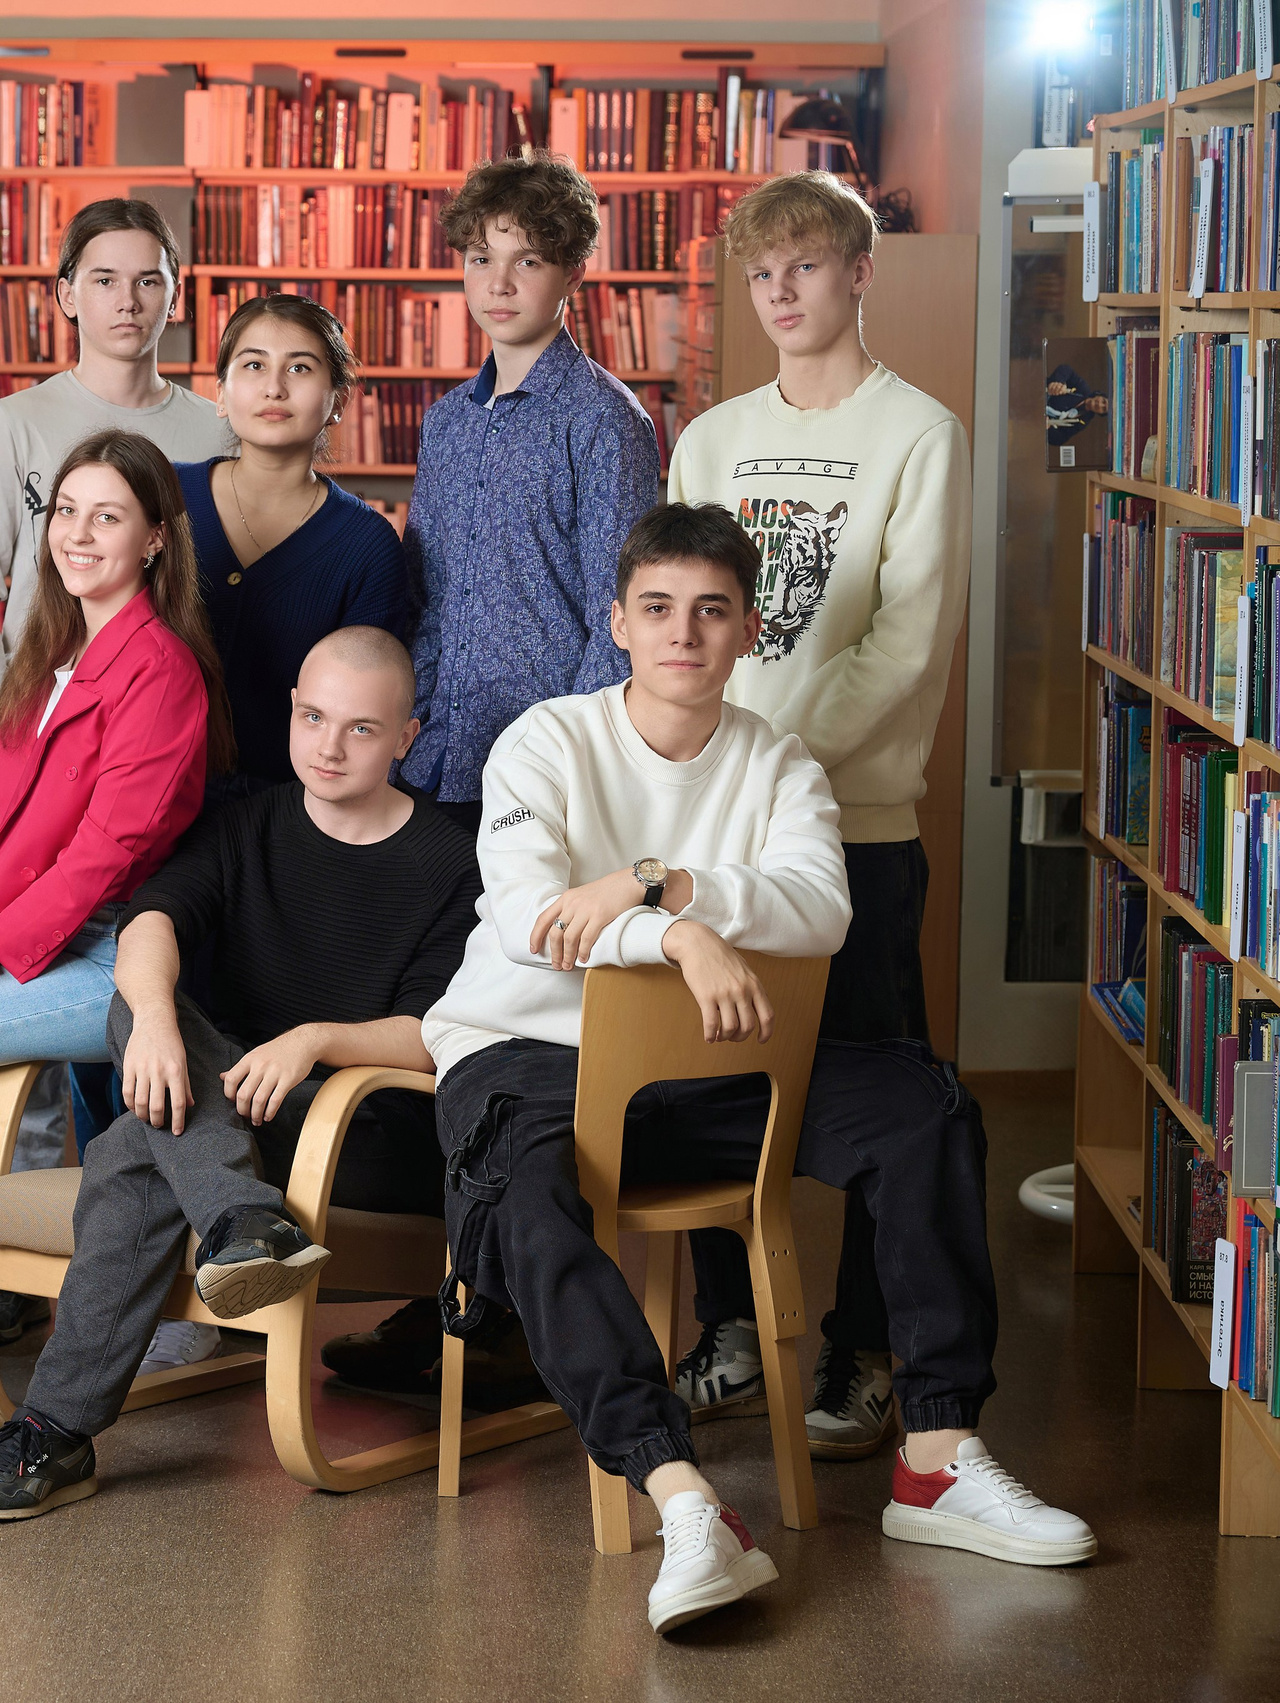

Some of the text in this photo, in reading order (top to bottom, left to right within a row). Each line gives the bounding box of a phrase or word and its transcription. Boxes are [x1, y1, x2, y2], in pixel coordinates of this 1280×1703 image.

[733, 462, 858, 476] SAVAGE
[737, 498, 795, 529] MOS
[493, 809, 531, 831] CRUSH
[1217, 1300, 1225, 1358] Эстетика
